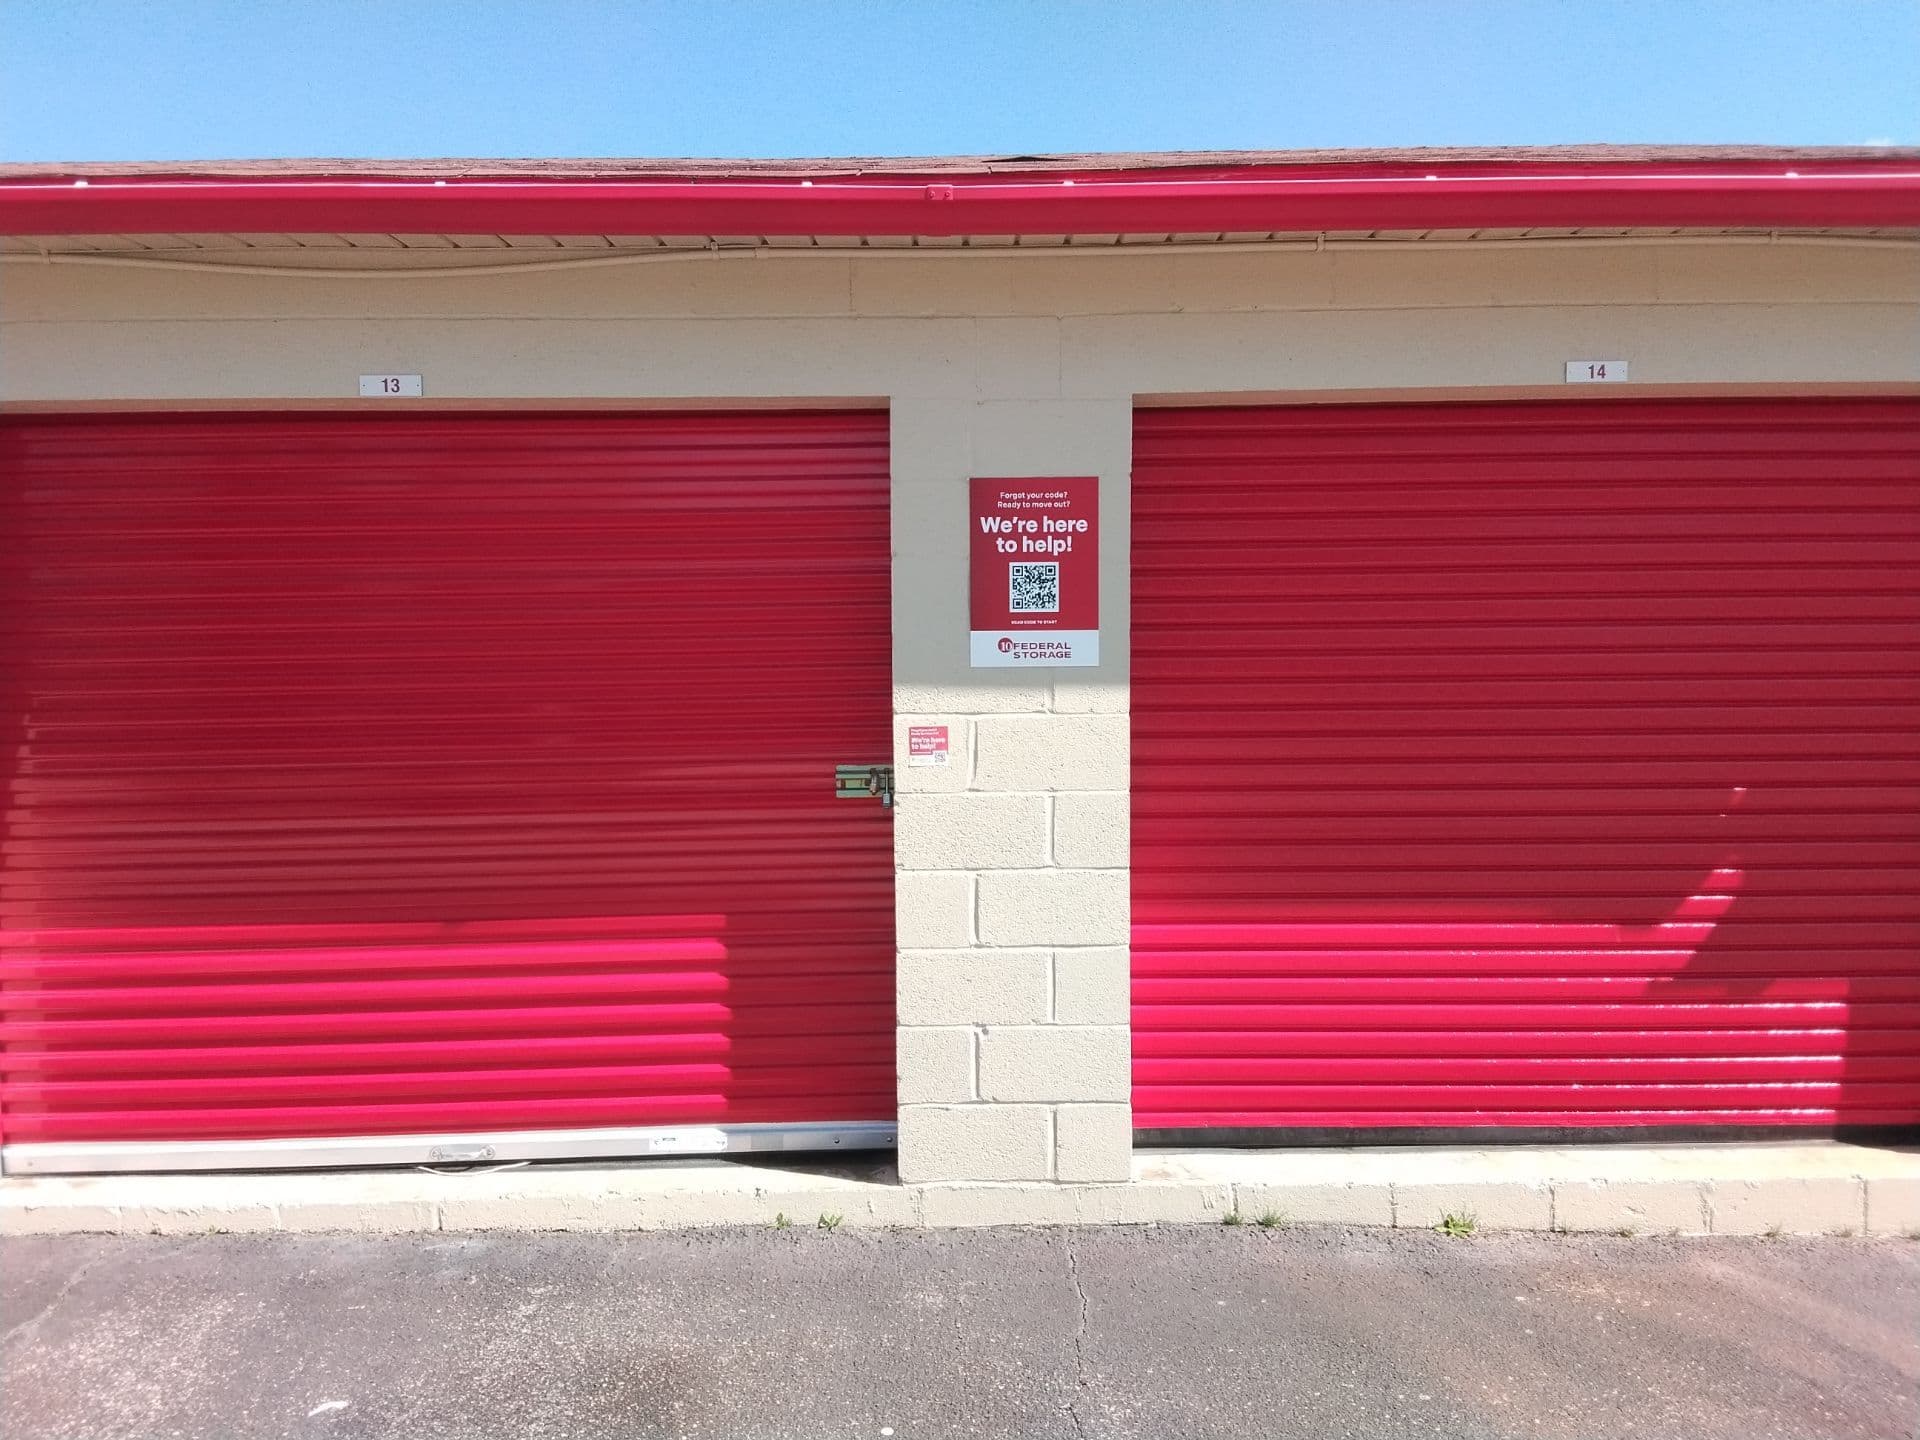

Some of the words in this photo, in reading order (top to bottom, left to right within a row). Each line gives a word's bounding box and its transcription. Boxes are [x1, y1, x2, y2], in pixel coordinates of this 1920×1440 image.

[1588, 364, 1606, 379] 14
[381, 377, 400, 393] 13
[1000, 492, 1026, 500] Forgot
[1026, 492, 1044, 500] your
[1044, 491, 1068, 499] code?
[997, 500, 1021, 509] Ready
[1053, 500, 1071, 508] out?
[980, 516, 1038, 533] We're
[1043, 515, 1088, 533] here
[996, 537, 1018, 553] to
[1022, 535, 1073, 556] help!
[1013, 642, 1072, 650] FEDERAL
[1013, 651, 1072, 659] STORAGE
